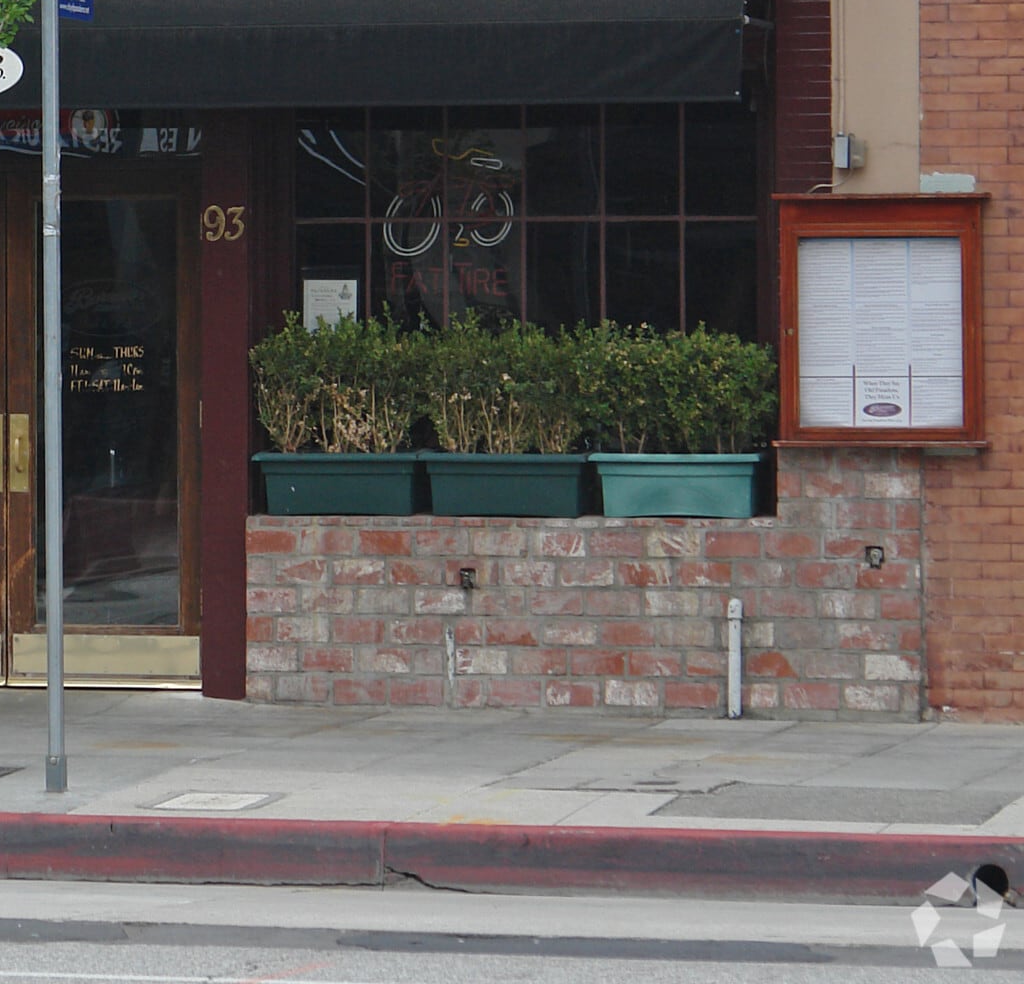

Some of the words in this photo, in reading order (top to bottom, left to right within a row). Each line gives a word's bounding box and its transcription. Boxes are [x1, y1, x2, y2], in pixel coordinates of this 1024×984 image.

[203, 205, 245, 242] 93
[390, 260, 445, 297] FAT
[452, 261, 509, 297] TIRE
